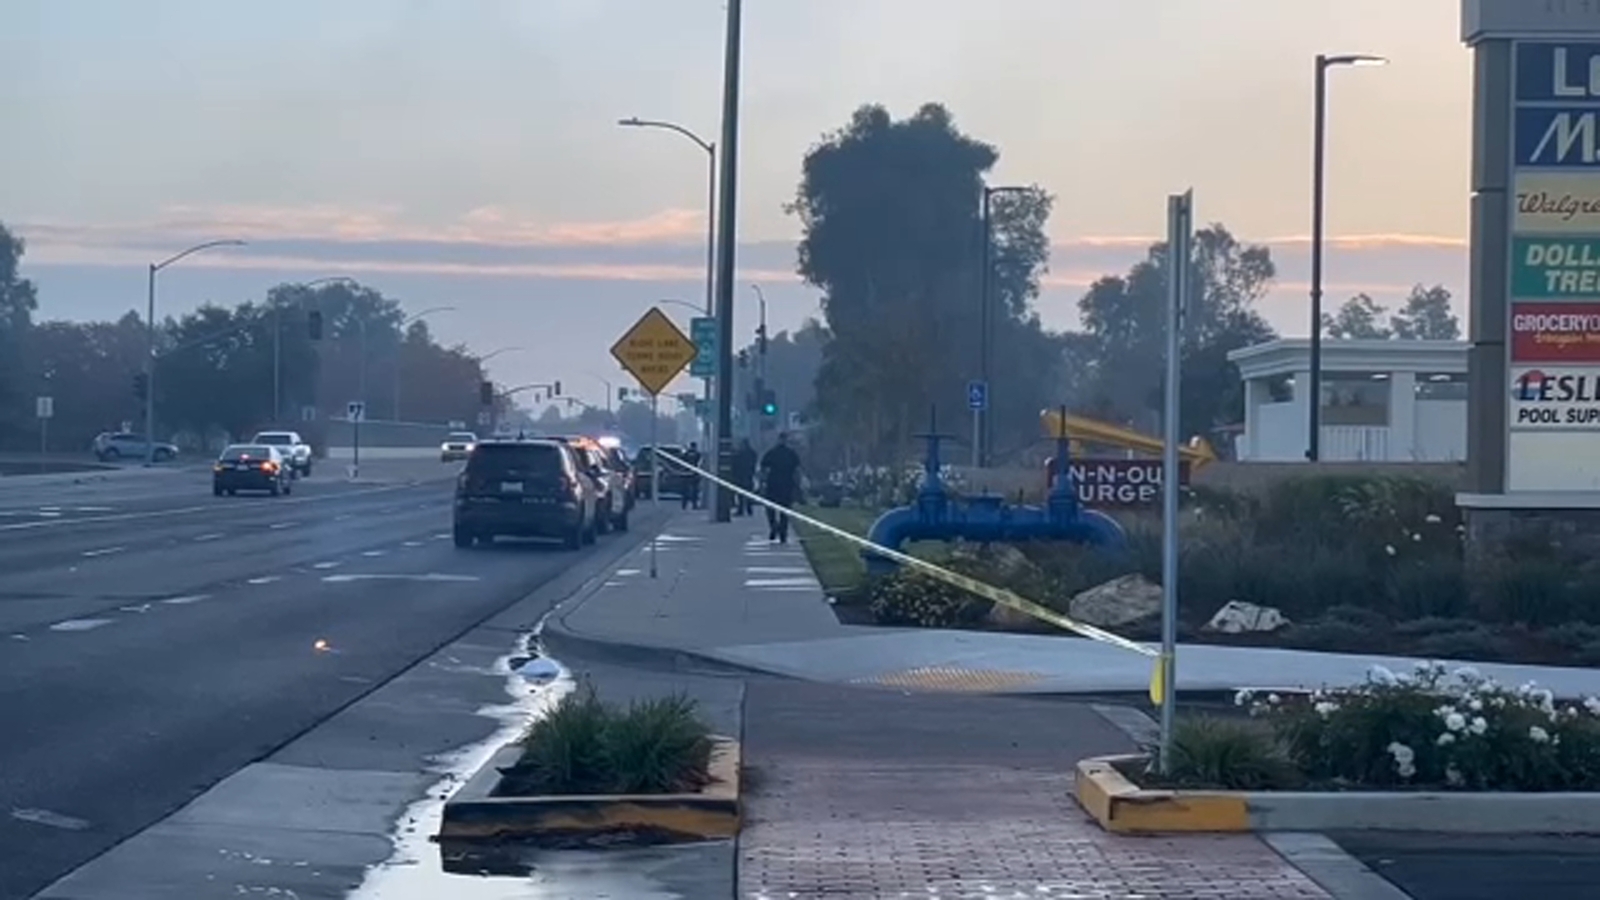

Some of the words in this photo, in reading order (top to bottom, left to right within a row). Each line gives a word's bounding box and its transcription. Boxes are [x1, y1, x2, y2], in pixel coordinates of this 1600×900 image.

[1529, 112, 1600, 162] M
[1525, 244, 1600, 266] DOLL
[1544, 270, 1600, 292] TRE
[1517, 408, 1561, 423] POOL
[1566, 408, 1600, 423] SUP
[1068, 465, 1163, 483] N-N-OU
[1078, 484, 1156, 502] URGE
